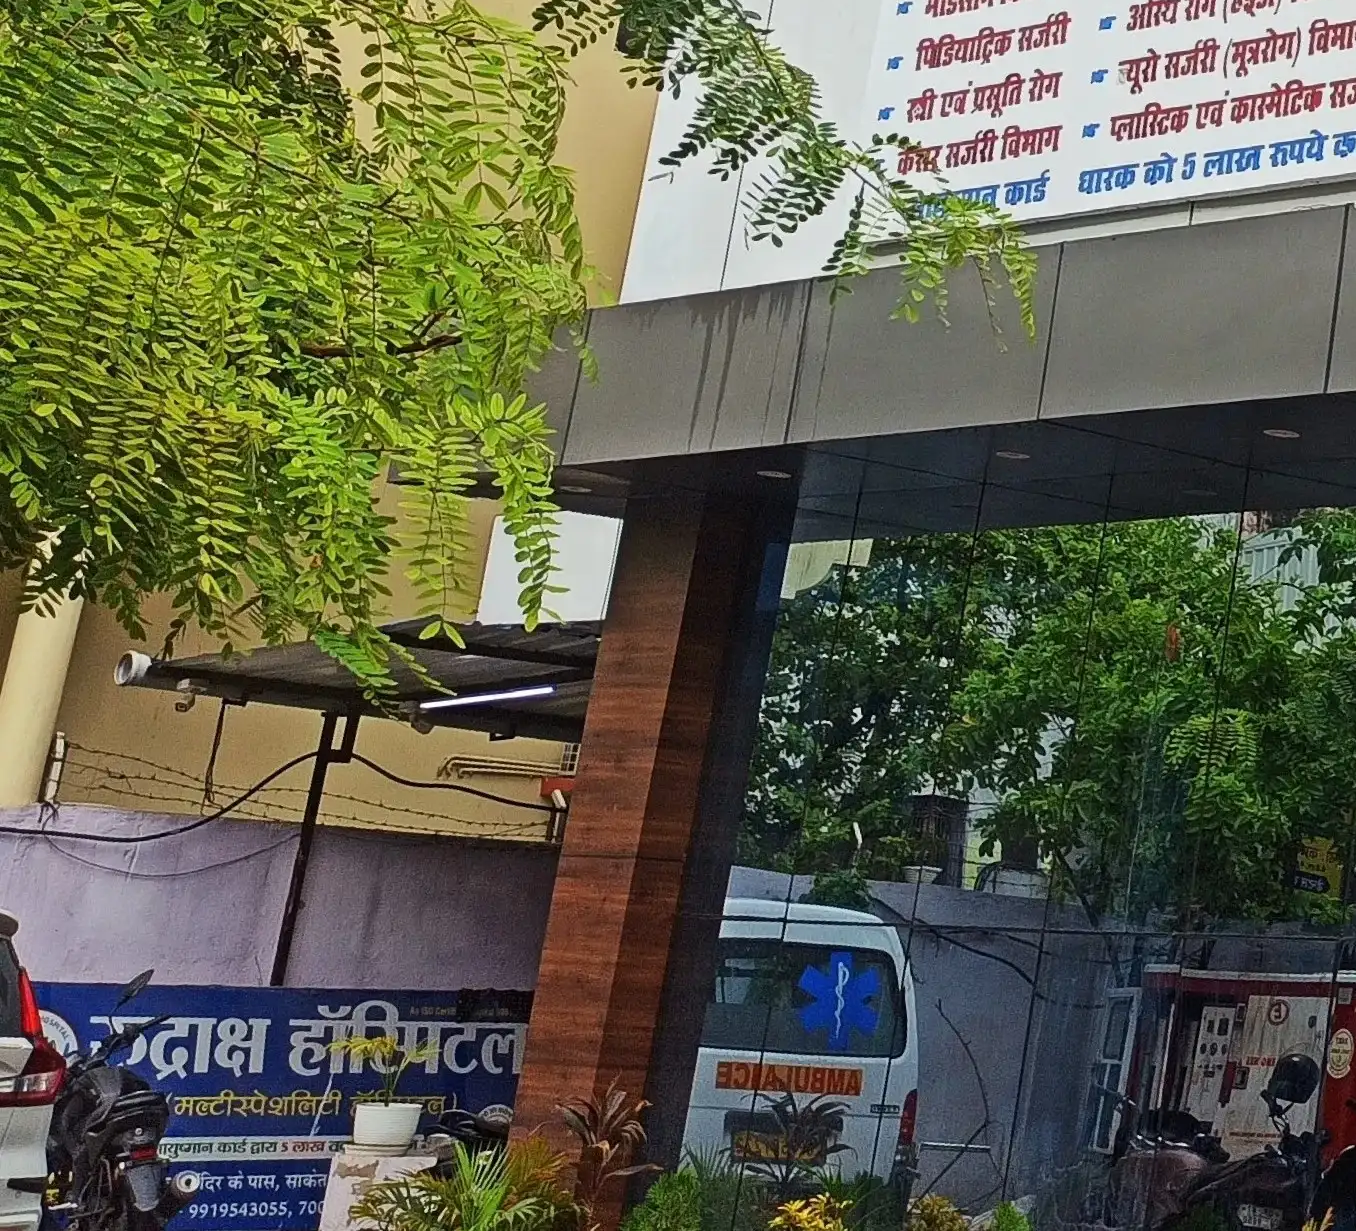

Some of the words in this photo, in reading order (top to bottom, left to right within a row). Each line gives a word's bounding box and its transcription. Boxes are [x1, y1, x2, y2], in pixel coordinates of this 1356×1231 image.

[1018, 12, 1071, 51] सर्जरी
[1165, 38, 1220, 79] सर्जरी
[941, 81, 973, 118] एवं
[1029, 69, 1062, 101] रोग
[1110, 103, 1192, 141] प्लास्टिक
[1196, 90, 1230, 129] एवं
[946, 129, 998, 168] सर्जरी
[1001, 126, 1062, 159] विभाग
[1004, 169, 1050, 205] कार्ड
[1144, 153, 1178, 185] को
[1182, 153, 1196, 180] 5
[1204, 145, 1264, 177] लाख
[288, 999, 528, 1077] हॉस्पिटल
[217, 1137, 247, 1154] कार्ड
[281, 1141, 289, 1152] 5
[292, 1140, 326, 1154] लाख
[228, 1171, 243, 1190] के
[247, 1174, 280, 1191] पास,
[189, 1202, 293, 1219] 9919543055,
